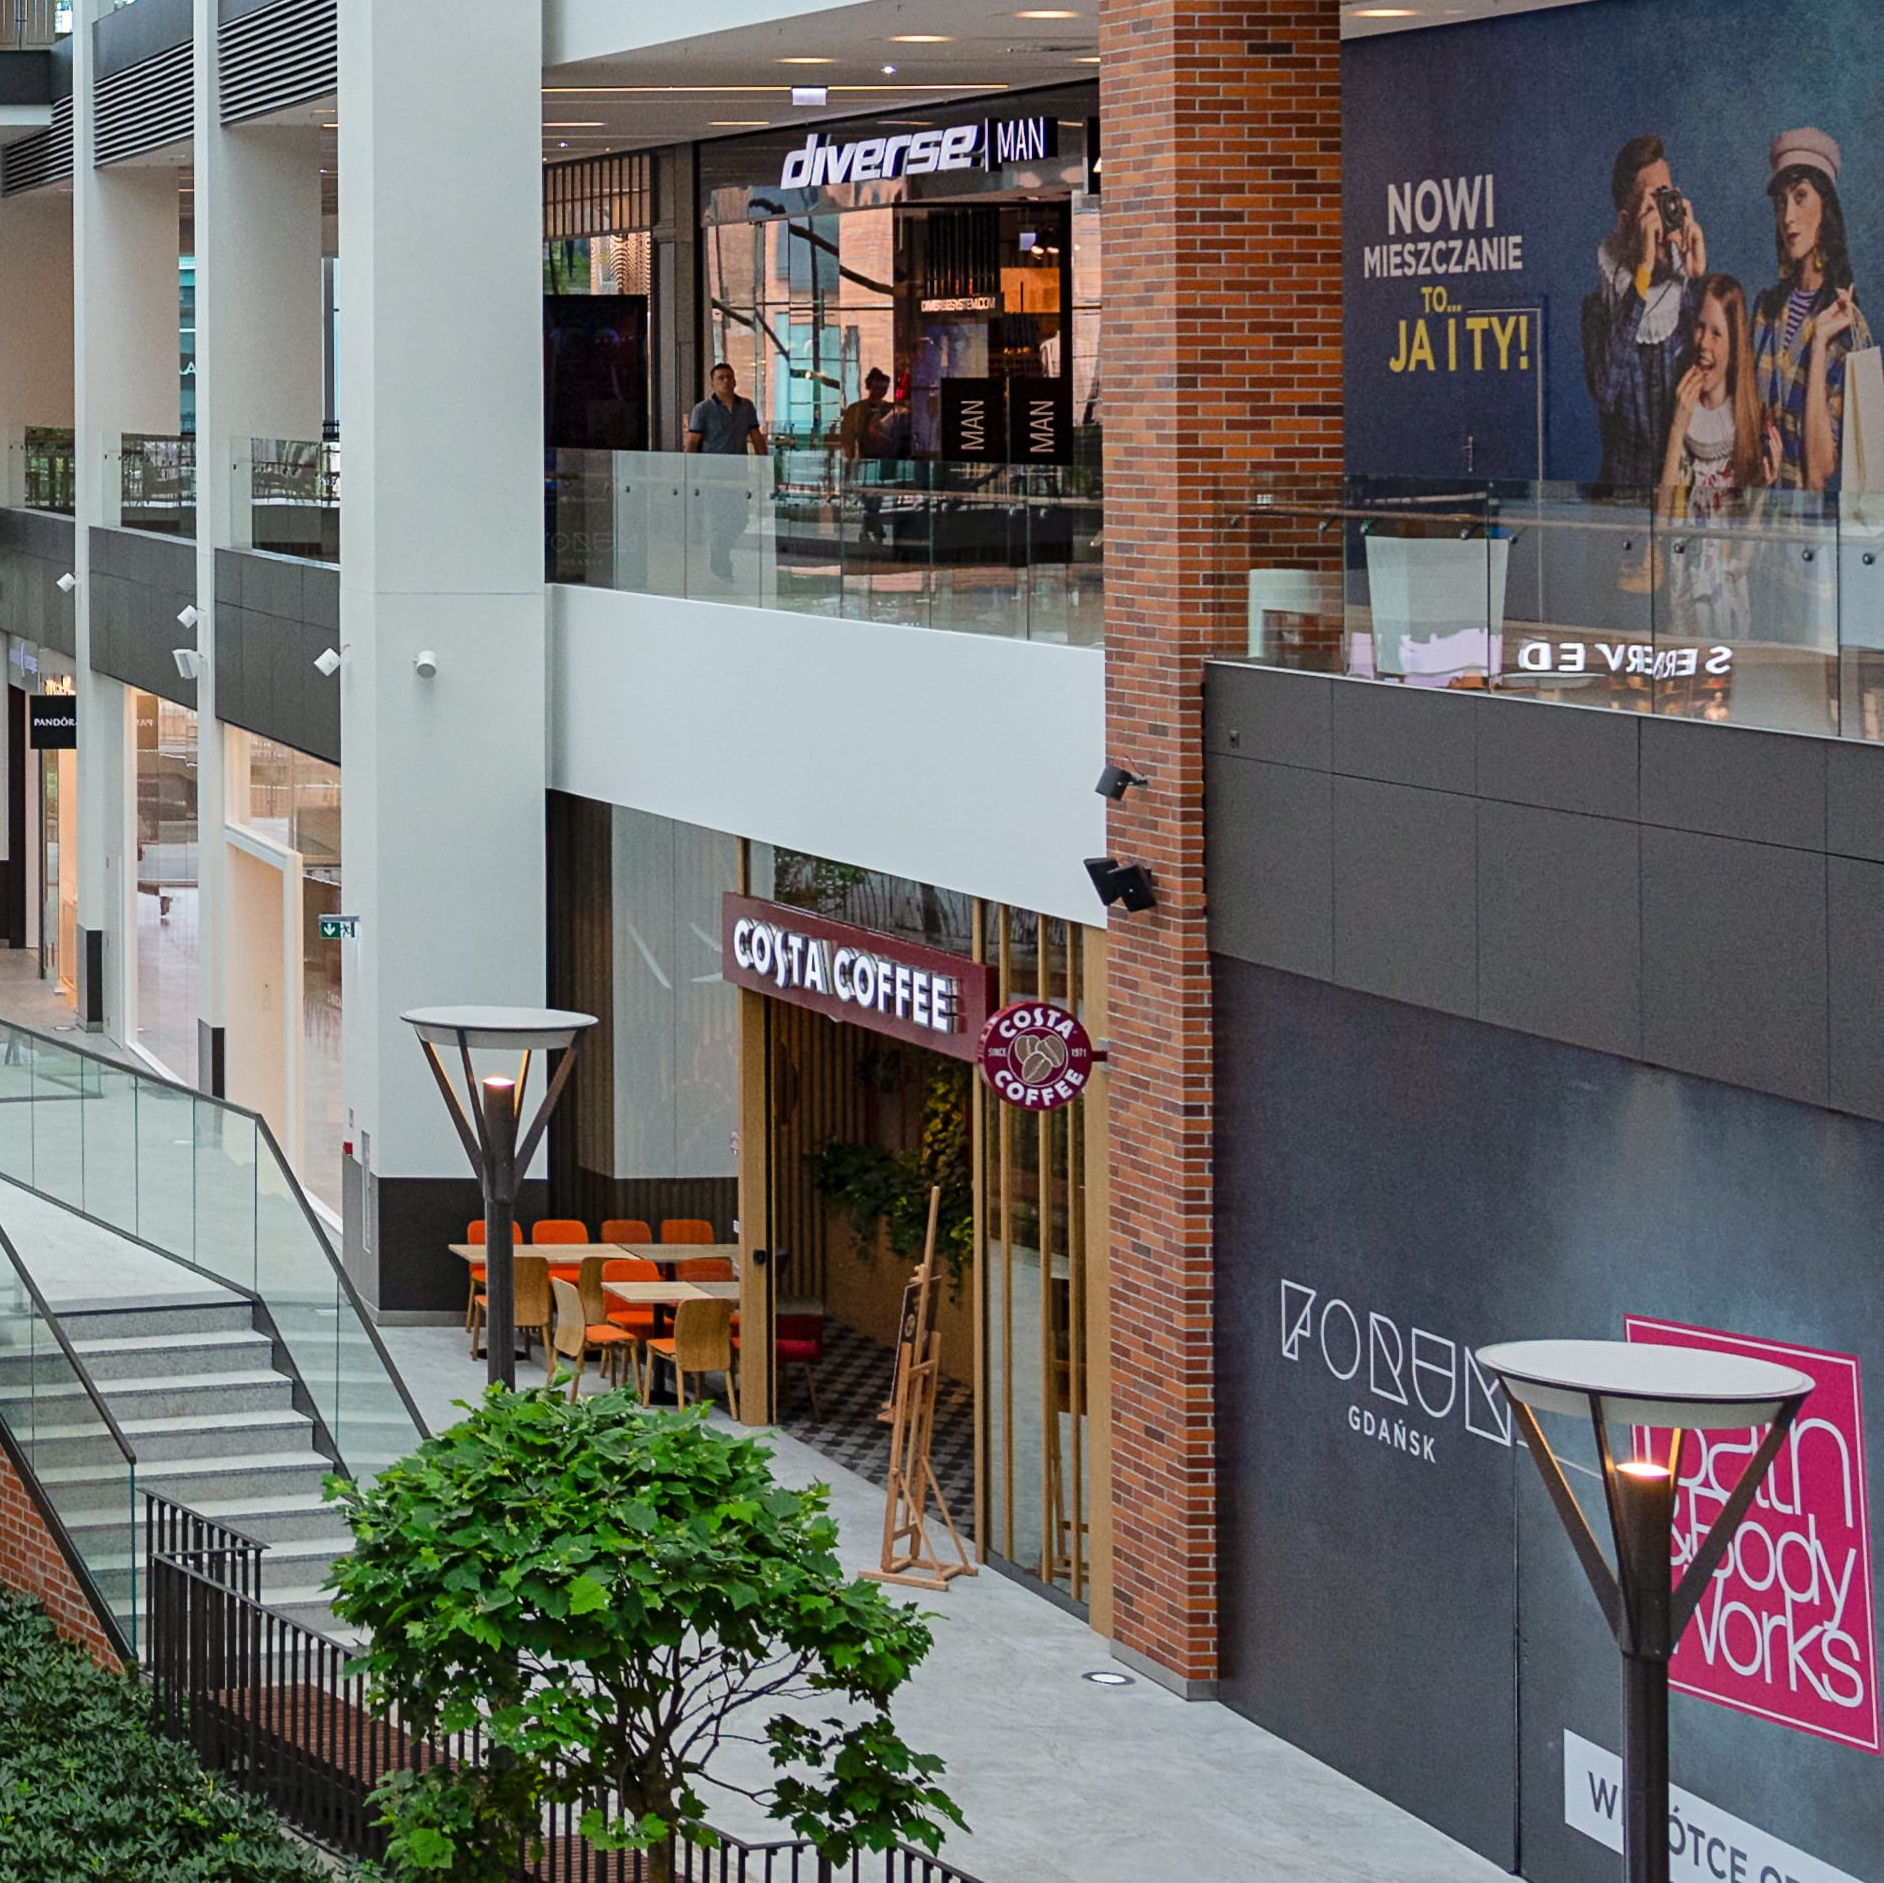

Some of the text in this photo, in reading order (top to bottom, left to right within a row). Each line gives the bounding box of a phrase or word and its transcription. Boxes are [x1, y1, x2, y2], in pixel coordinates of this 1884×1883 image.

[780, 117, 1045, 190] diverse MAN
[1386, 174, 1495, 235] NOWI
[1363, 235, 1523, 279] MIESZCZANIE
[1421, 286, 1463, 314] TO...
[1388, 314, 1530, 374] JA I TY!
[961, 400, 985, 450] MAN
[1030, 400, 1055, 453] MAN
[33, 716, 77, 727] PANDOR
[734, 918, 957, 1033] COSTA COFFEE
[999, 1007, 1075, 1040] COSTA
[994, 1068, 1085, 1106] COFFEE
[1348, 1404, 1436, 1463] GDAŃSK
[1587, 1770, 1748, 1883] WÓTCE
